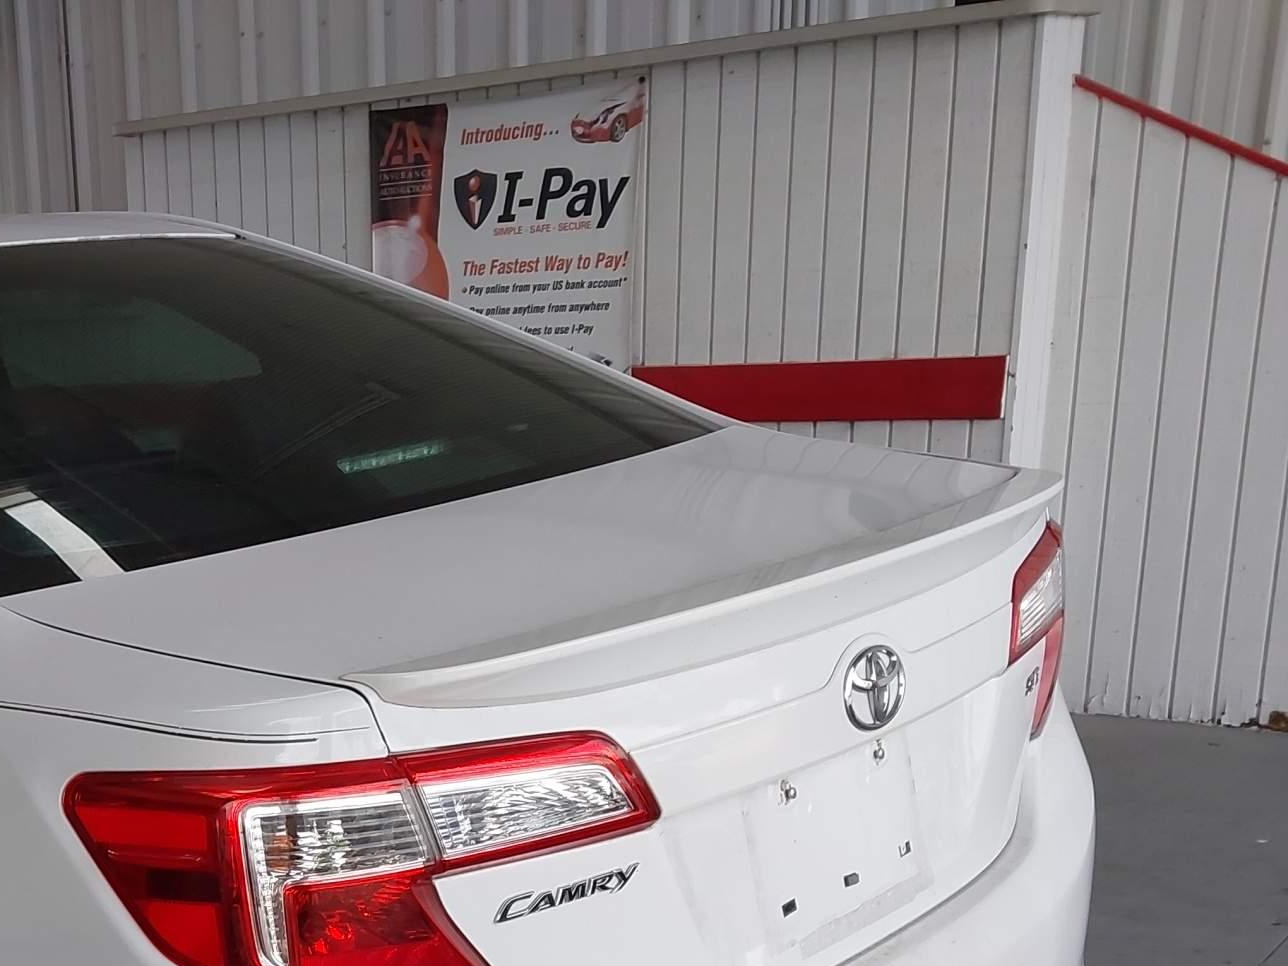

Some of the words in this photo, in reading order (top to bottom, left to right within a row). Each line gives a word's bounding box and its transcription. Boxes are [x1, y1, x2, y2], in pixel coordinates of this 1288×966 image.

[460, 121, 560, 146] Introducing...
[497, 167, 631, 229] I-Pay
[493, 225, 523, 237] SIMPLE
[529, 224, 552, 235] SAFE
[558, 220, 592, 232] SECURE
[463, 261, 485, 276] The
[489, 257, 540, 275] Fastest
[545, 255, 573, 274] Way
[577, 254, 591, 270] to
[594, 251, 629, 272] Pay!
[468, 285, 484, 297] Pay
[485, 283, 510, 294] online
[511, 282, 531, 293] from
[532, 283, 551, 295] your
[552, 280, 564, 291] US
[565, 279, 586, 290] bank
[485, 305, 510, 316] online
[512, 303, 546, 317] anytime
[547, 303, 567, 313] from
[568, 301, 610, 316] anywhere
[543, 326, 552, 336] to
[554, 326, 569, 336] use
[571, 324, 594, 337] I-Pay
[493, 862, 640, 923] CAMRY
